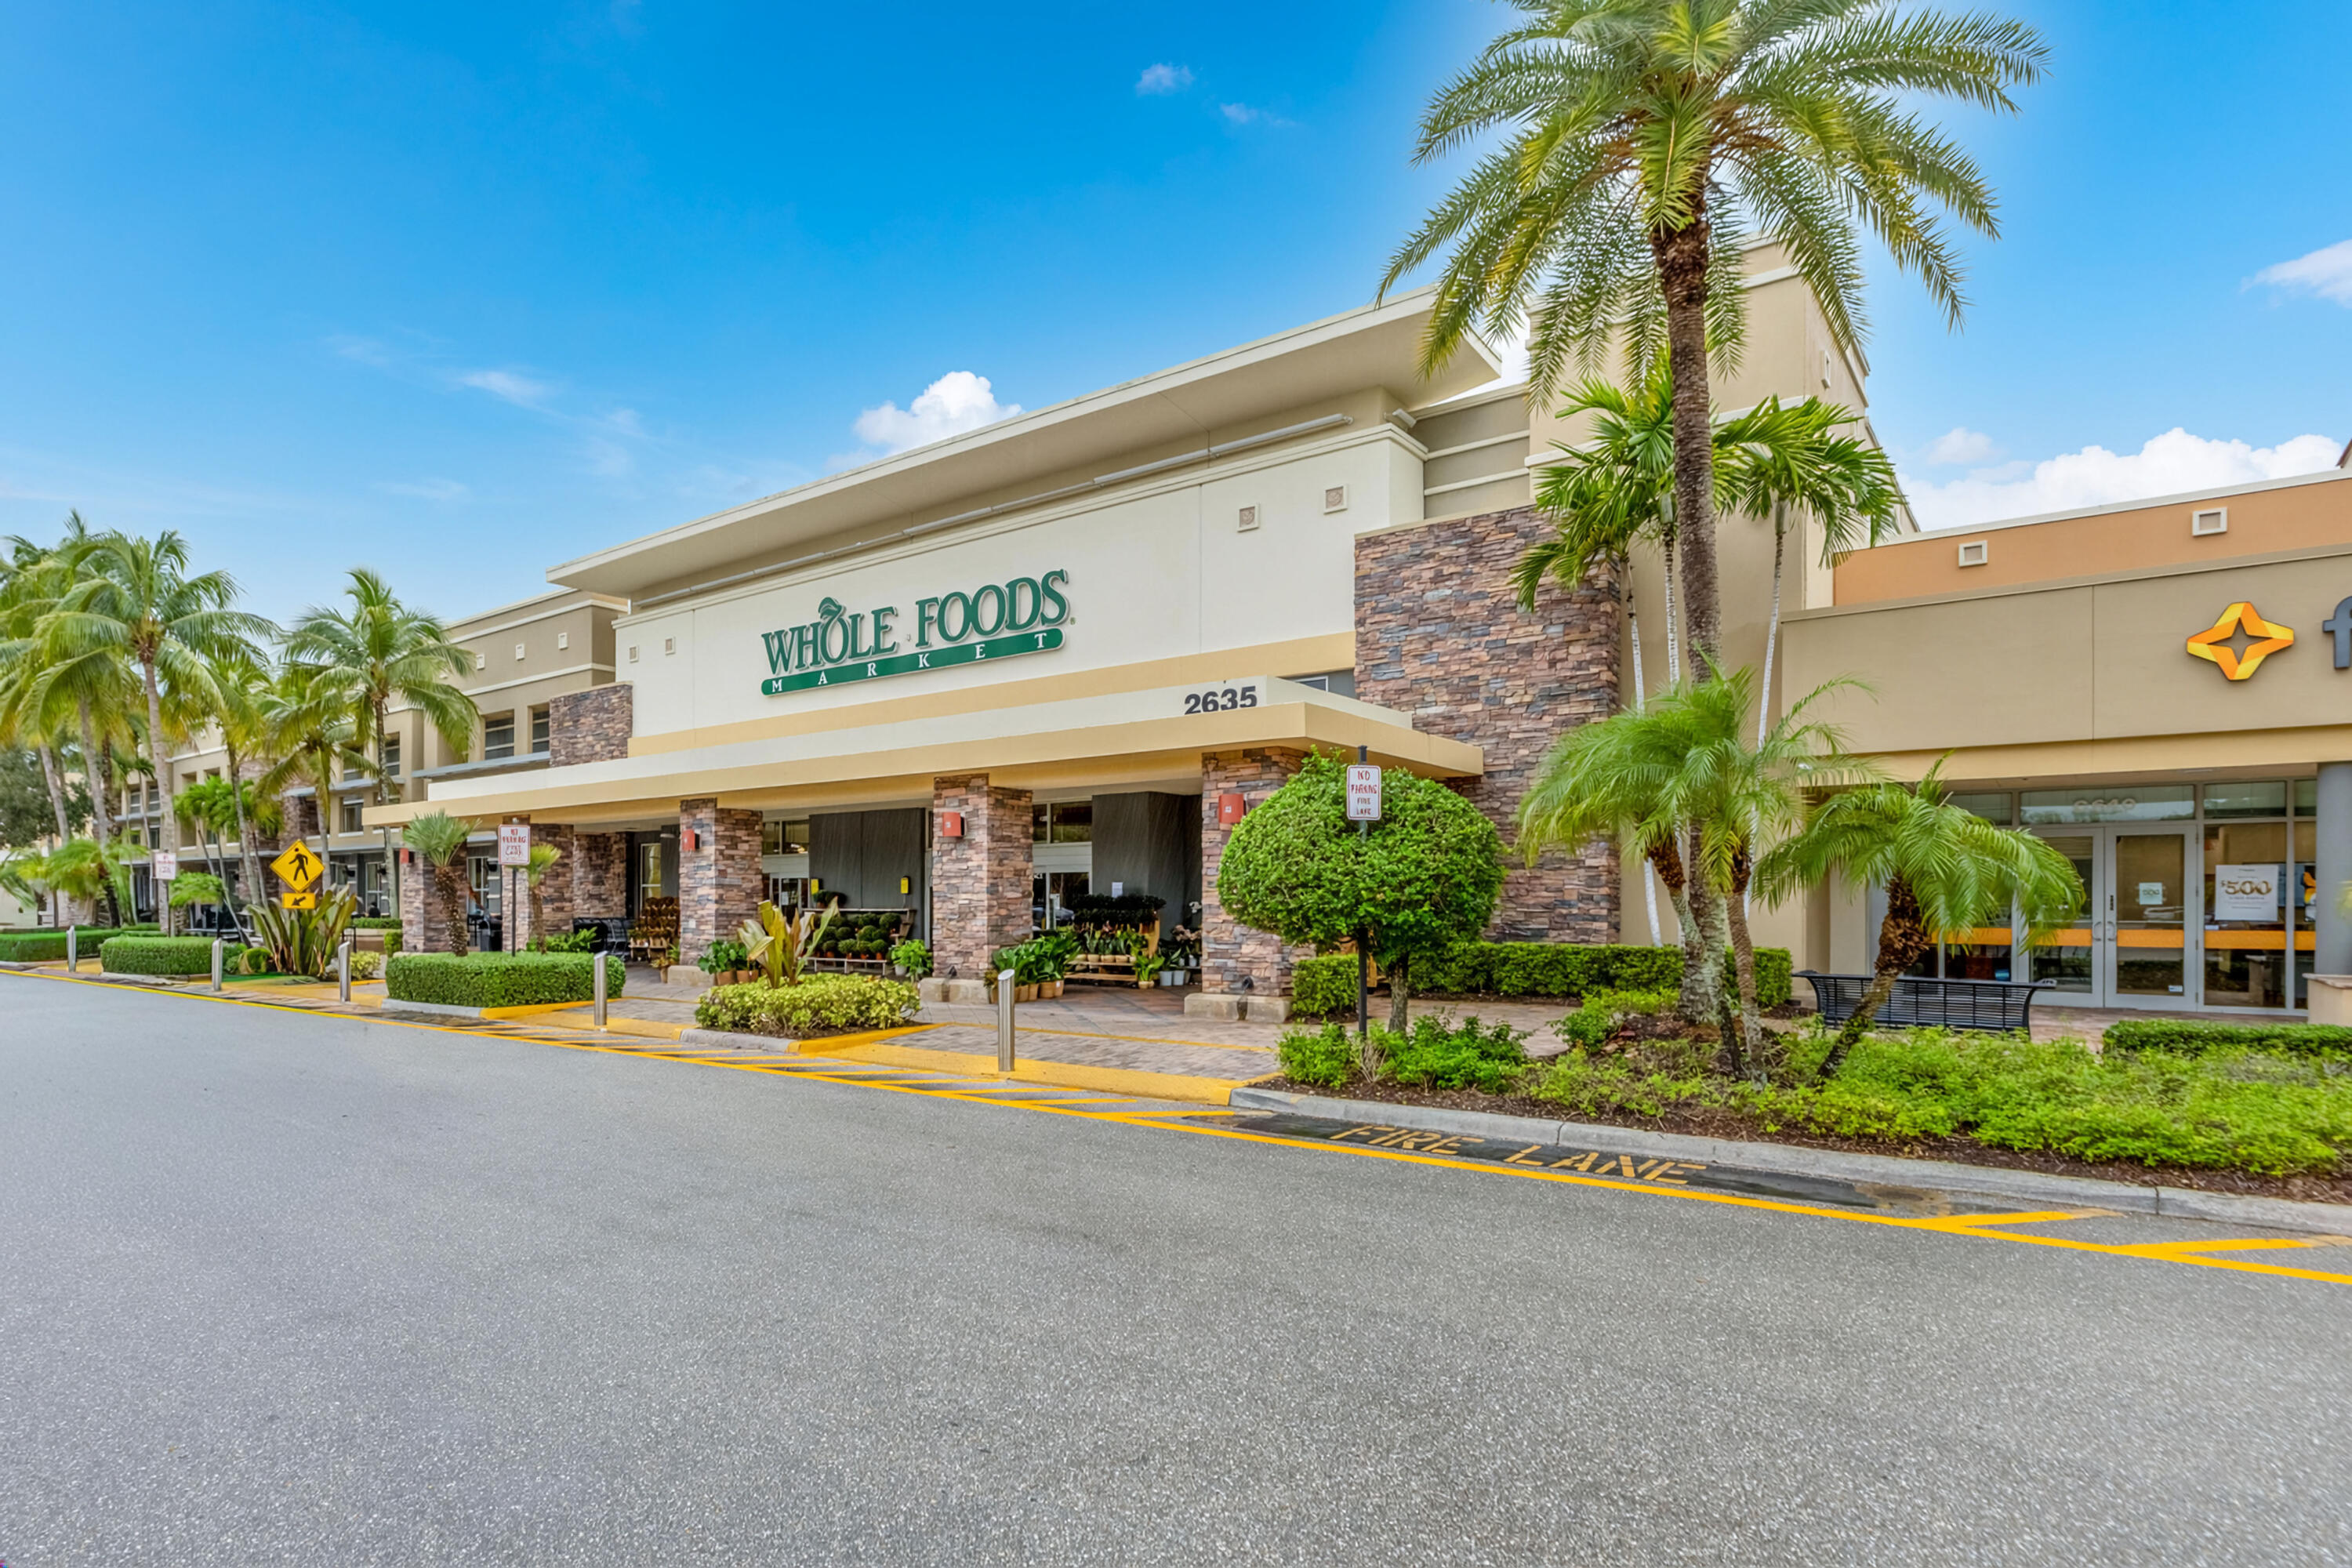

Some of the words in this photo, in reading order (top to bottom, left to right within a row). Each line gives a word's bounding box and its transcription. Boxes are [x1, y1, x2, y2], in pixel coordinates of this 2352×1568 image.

[761, 597, 898, 675] WHOLE
[916, 568, 1068, 648] FOODS
[771, 632, 1047, 693] MARKET
[1184, 685, 1258, 715] 2635
[1358, 771, 1370, 781] NO
[2220, 880, 2272, 895] $500
[1330, 1125, 1486, 1155] FIRE
[1504, 1145, 1707, 1185] LANE
